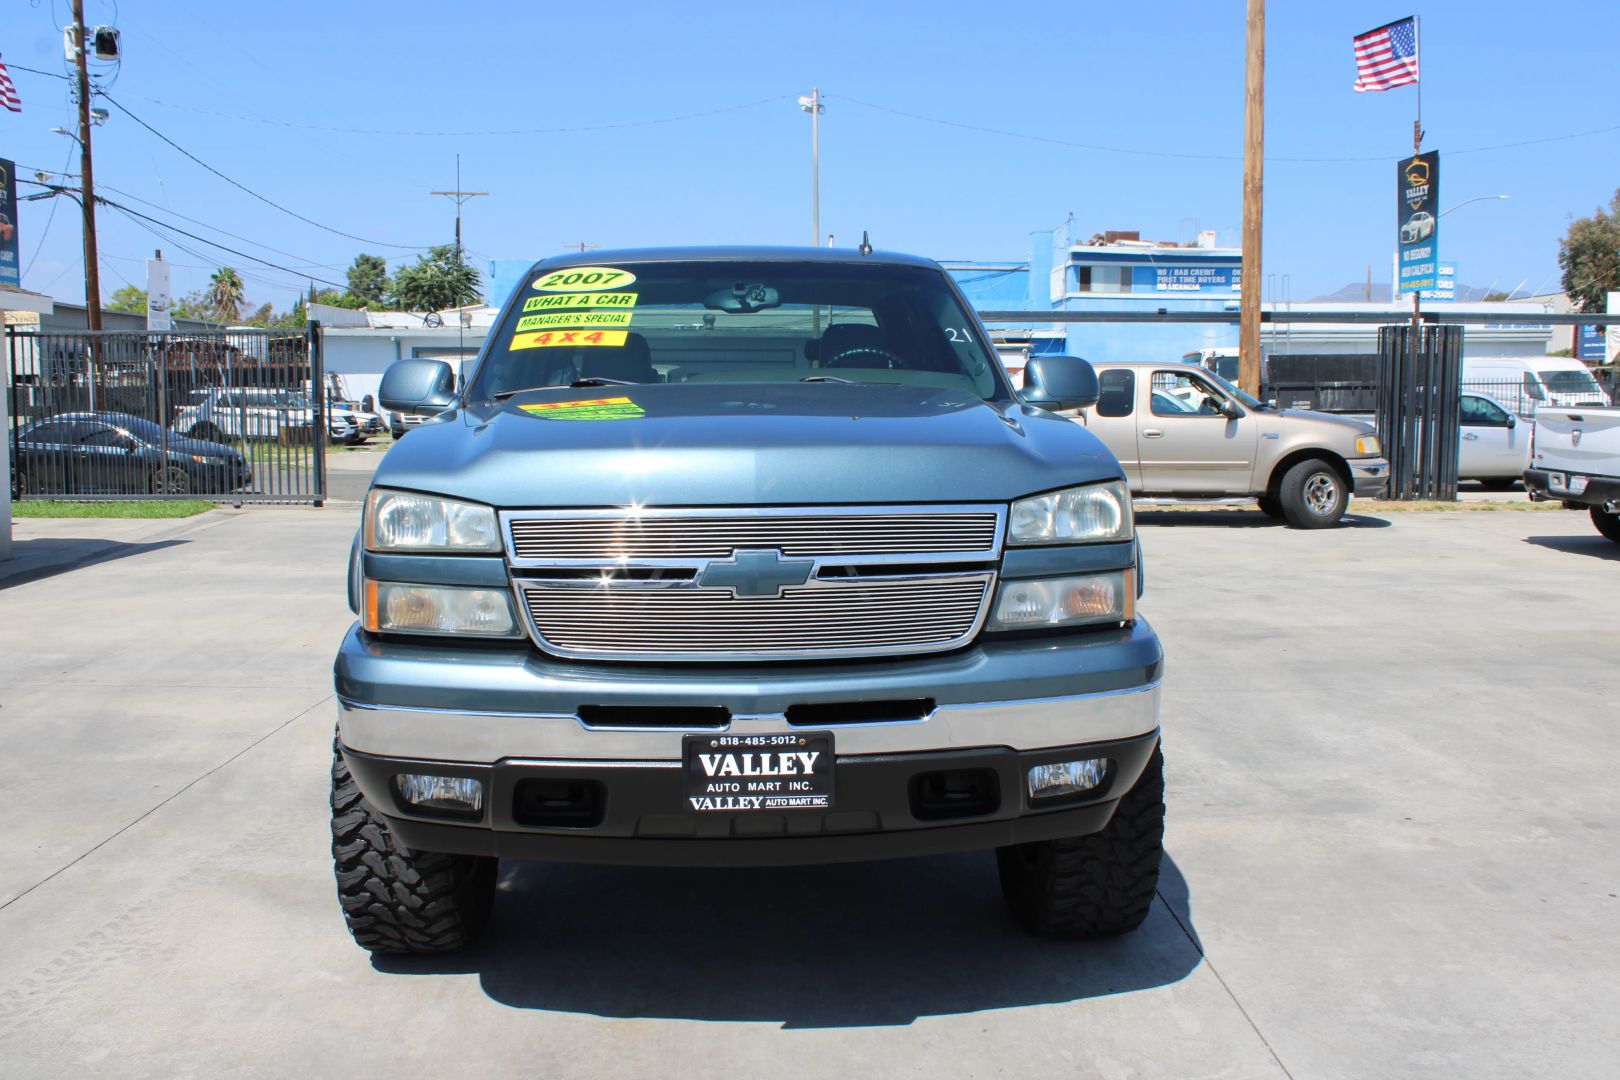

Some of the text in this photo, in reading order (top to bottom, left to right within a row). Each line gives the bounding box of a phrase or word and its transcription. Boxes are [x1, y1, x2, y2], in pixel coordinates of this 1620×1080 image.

[542, 273, 624, 287] 2007
[1157, 276, 1177, 284] FIRST
[1179, 276, 1197, 284] TIME
[1197, 276, 1226, 284] BUYERS
[527, 294, 633, 309] WHAT A CAR
[520, 313, 627, 327] MANAGER'S SPECIAL
[720, 736, 796, 746] 818-485-5012
[698, 751, 820, 777] VALLEY
[706, 781, 813, 792] AUTO MART INC.
[689, 796, 829, 811] VALLEY AUTO MART INC.
